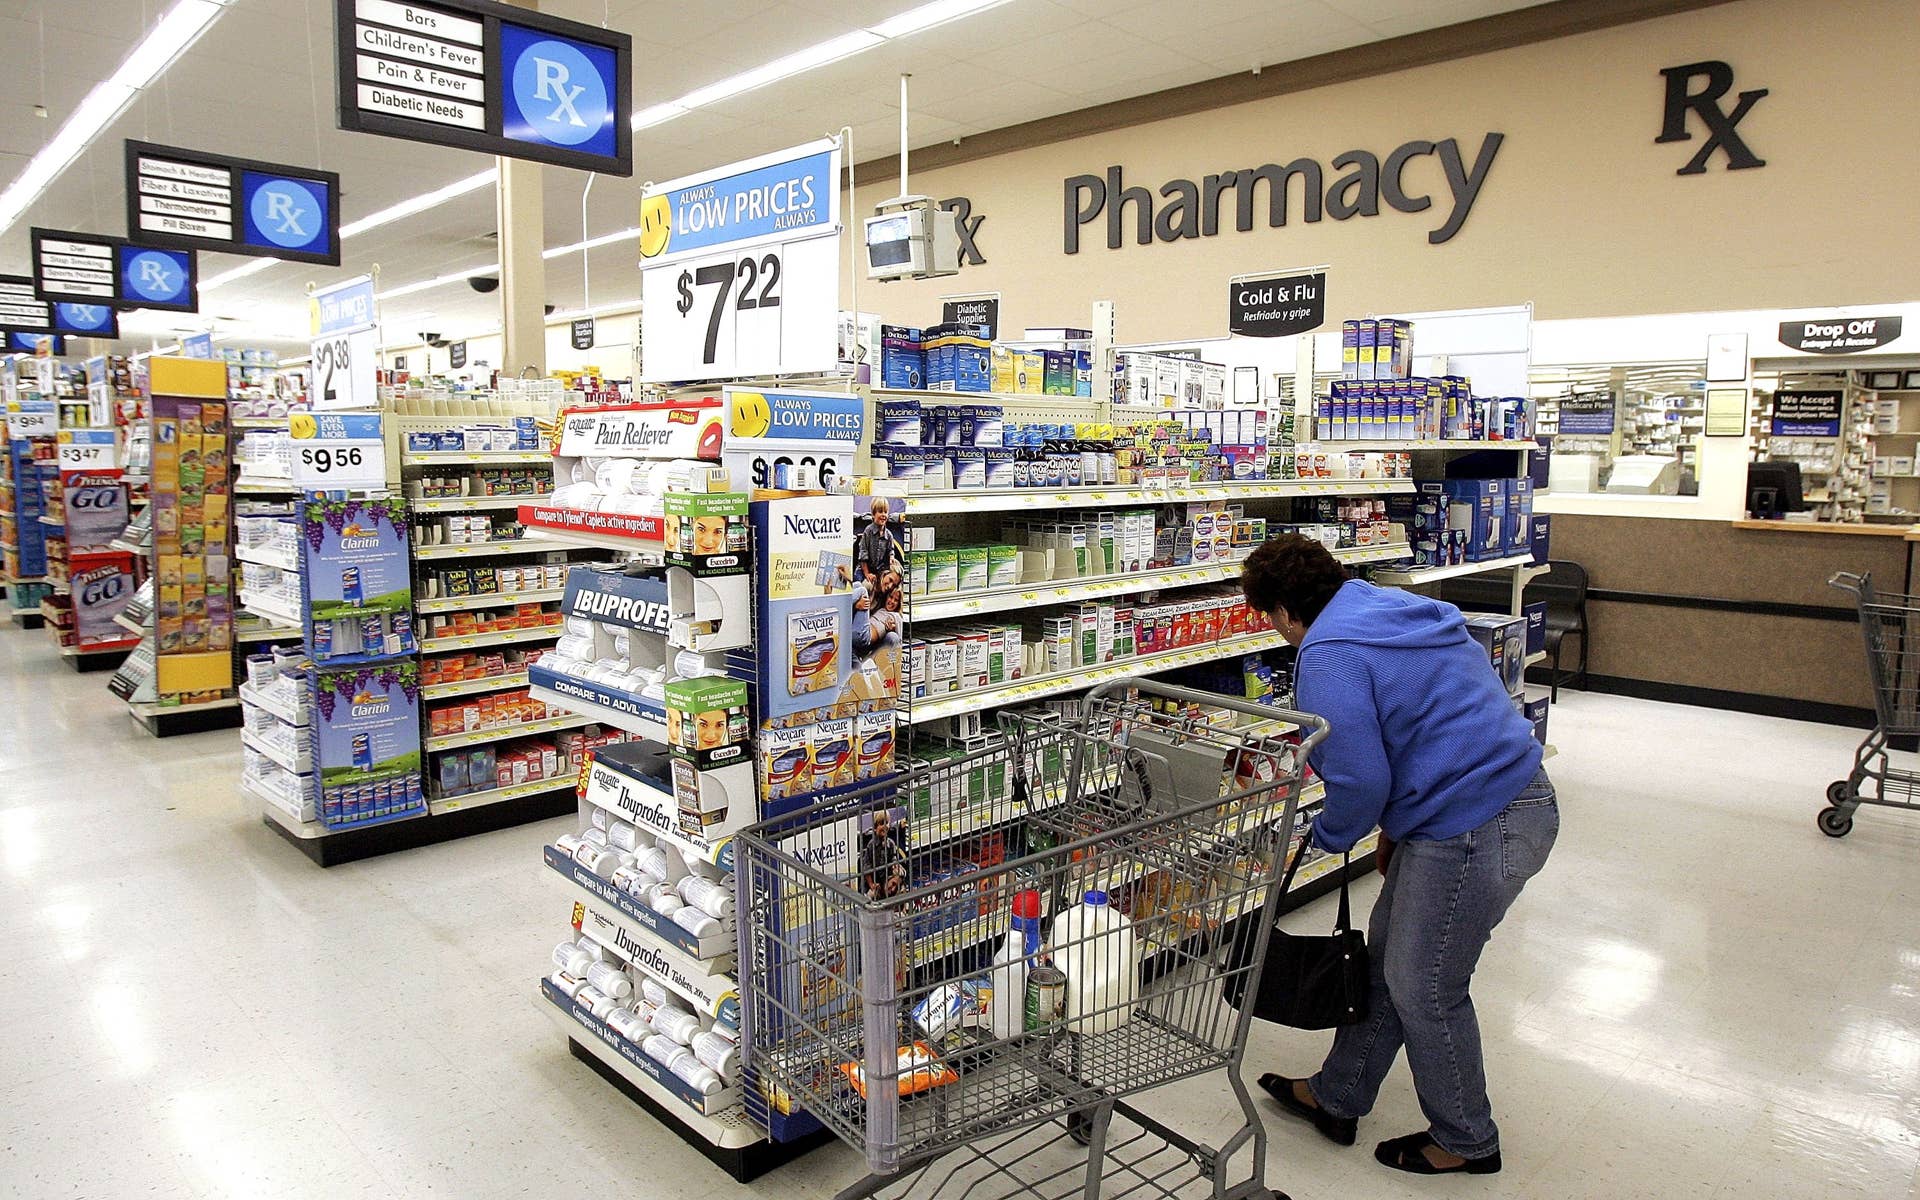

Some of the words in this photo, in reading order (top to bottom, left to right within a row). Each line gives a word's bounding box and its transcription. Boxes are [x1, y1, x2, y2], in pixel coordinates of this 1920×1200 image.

[405, 9, 437, 28] Bars
[364, 30, 435, 57] Children's
[441, 46, 478, 66] Fever
[378, 61, 408, 83] Pain
[413, 70, 425, 82] &
[430, 72, 467, 91] Fever
[533, 57, 587, 127] Rx
[372, 91, 423, 112] Diabetic
[427, 101, 464, 119] Needs
[1654, 60, 1769, 176] Rx
[141, 179, 167, 190] Fiber
[171, 184, 179, 192] &
[183, 185, 229, 199] Laxatives
[680, 185, 715, 204] ALWAYS
[1064, 132, 1505, 254] Pharmacy
[154, 199, 217, 215] Thermometers
[678, 196, 729, 235] LOW
[735, 175, 814, 223] PRICES
[265, 191, 307, 236] Rx
[774, 209, 816, 230] ALWAYS
[163, 218, 177, 228] Pill
[179, 221, 207, 232] Boxes
[140, 260, 170, 292] Rx
[1239, 288, 1273, 306] Cold
[1277, 287, 1290, 303] &
[1294, 284, 1315, 301] Flu
[957, 303, 987, 315] Diabetic
[1243, 309, 1280, 322] Resfriado
[1283, 311, 1289, 320] y
[1289, 307, 1311, 320] gripe
[956, 313, 987, 325] Supplies
[1803, 323, 1844, 339] Drop
[1847, 320, 1876, 335] Off
[774, 399, 811, 410] ALWAYS
[1781, 395, 1798, 404] We
[1800, 395, 1835, 406] Accept
[320, 415, 343, 424] SAVE
[884, 408, 919, 416] Mucinex
[975, 409, 1001, 417] Mucinex
[321, 423, 344, 431] EVEN
[568, 418, 596, 432] equate
[773, 411, 810, 426] LOW
[813, 412, 860, 429] PRICES
[321, 430, 347, 439] MORE
[595, 422, 620, 445] Pain
[622, 421, 673, 445] Reliever
[825, 429, 861, 440] ALWAYS
[894, 452, 924, 461] Mucinex
[957, 450, 984, 458] Mucinex
[987, 450, 1013, 459] Mucinex
[71, 488, 117, 509] GO
[533, 507, 557, 524] Compare
[557, 512, 563, 522] to
[585, 512, 607, 529] Caplets
[607, 515, 625, 529] active
[625, 515, 656, 534] ingredient
[783, 514, 842, 540] Nexcare
[341, 538, 379, 549] Claritin
[710, 558, 735, 566] Excedrin
[775, 558, 818, 571] Premium
[449, 572, 467, 580] Advil
[475, 569, 493, 577] Advil
[774, 571, 806, 582] Bandage
[82, 576, 122, 606] GO
[478, 582, 496, 590] Advil
[774, 582, 792, 592] Pack
[573, 589, 674, 629] IBUPROFE
[799, 616, 834, 633] Nexcare
[934, 648, 954, 656] Mucus
[933, 662, 951, 670] Cough
[883, 678, 897, 689] 3M
[555, 681, 596, 701] COMPARE
[598, 693, 610, 705] TO
[708, 692, 731, 700] headache
[731, 688, 744, 696] relief
[351, 703, 390, 717] Claritin
[864, 711, 892, 726] Nexcare
[817, 720, 848, 734] Nexcare
[774, 728, 806, 743] Nexcare
[713, 748, 738, 759] Excedrin
[593, 768, 620, 789] equate
[616, 786, 671, 832] Ibuprofen
[573, 867, 596, 891] Compare
[596, 881, 603, 895] to
[620, 899, 633, 913] active
[633, 906, 657, 929] ingredient
[614, 926, 670, 977] Ibuprofen
[671, 970, 694, 994] Tablets,
[572, 1005, 596, 1031] Compare
[596, 1022, 604, 1036] to
[621, 1044, 635, 1060] active
[635, 1053, 660, 1079] ingredient
